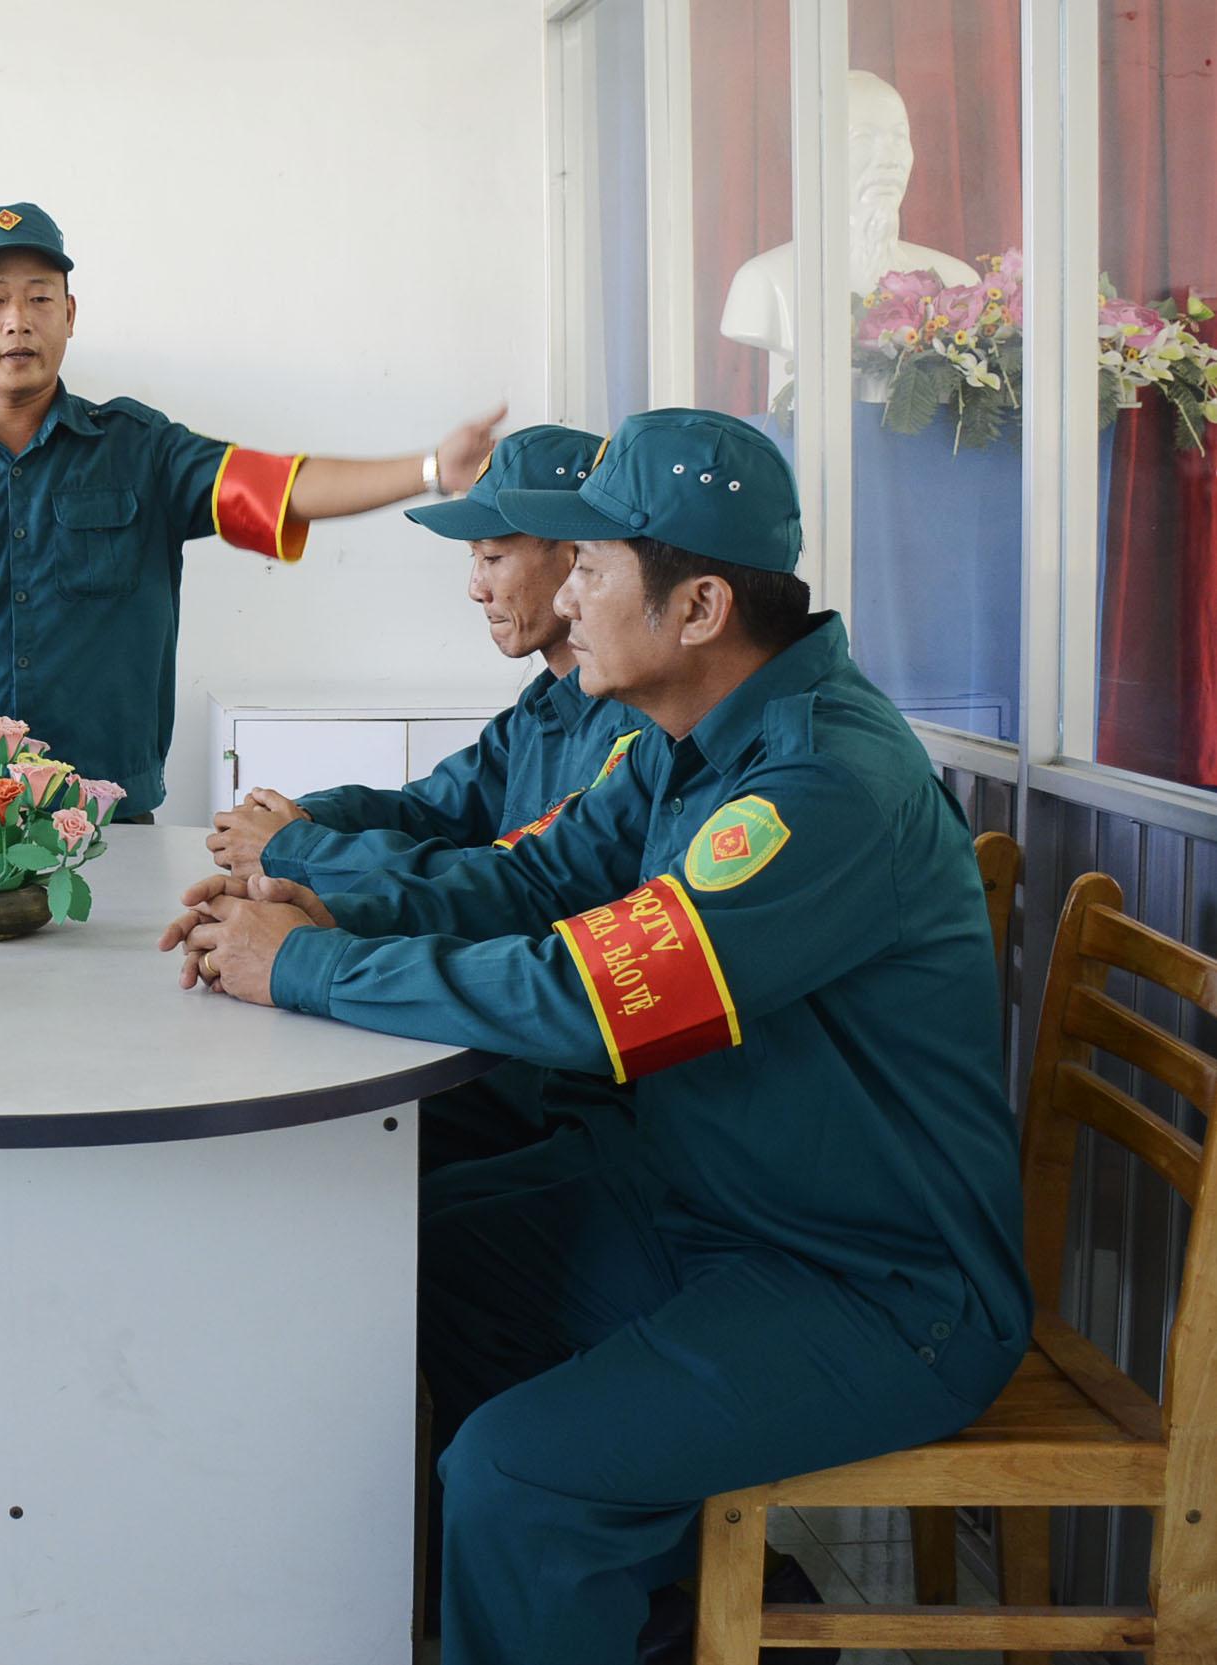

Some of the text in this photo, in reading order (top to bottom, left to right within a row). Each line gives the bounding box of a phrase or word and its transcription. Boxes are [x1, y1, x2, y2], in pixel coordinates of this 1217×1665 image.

[623, 887, 685, 951] DQTV
[601, 942, 649, 988] BẢO
[616, 982, 662, 1016] VỆ
